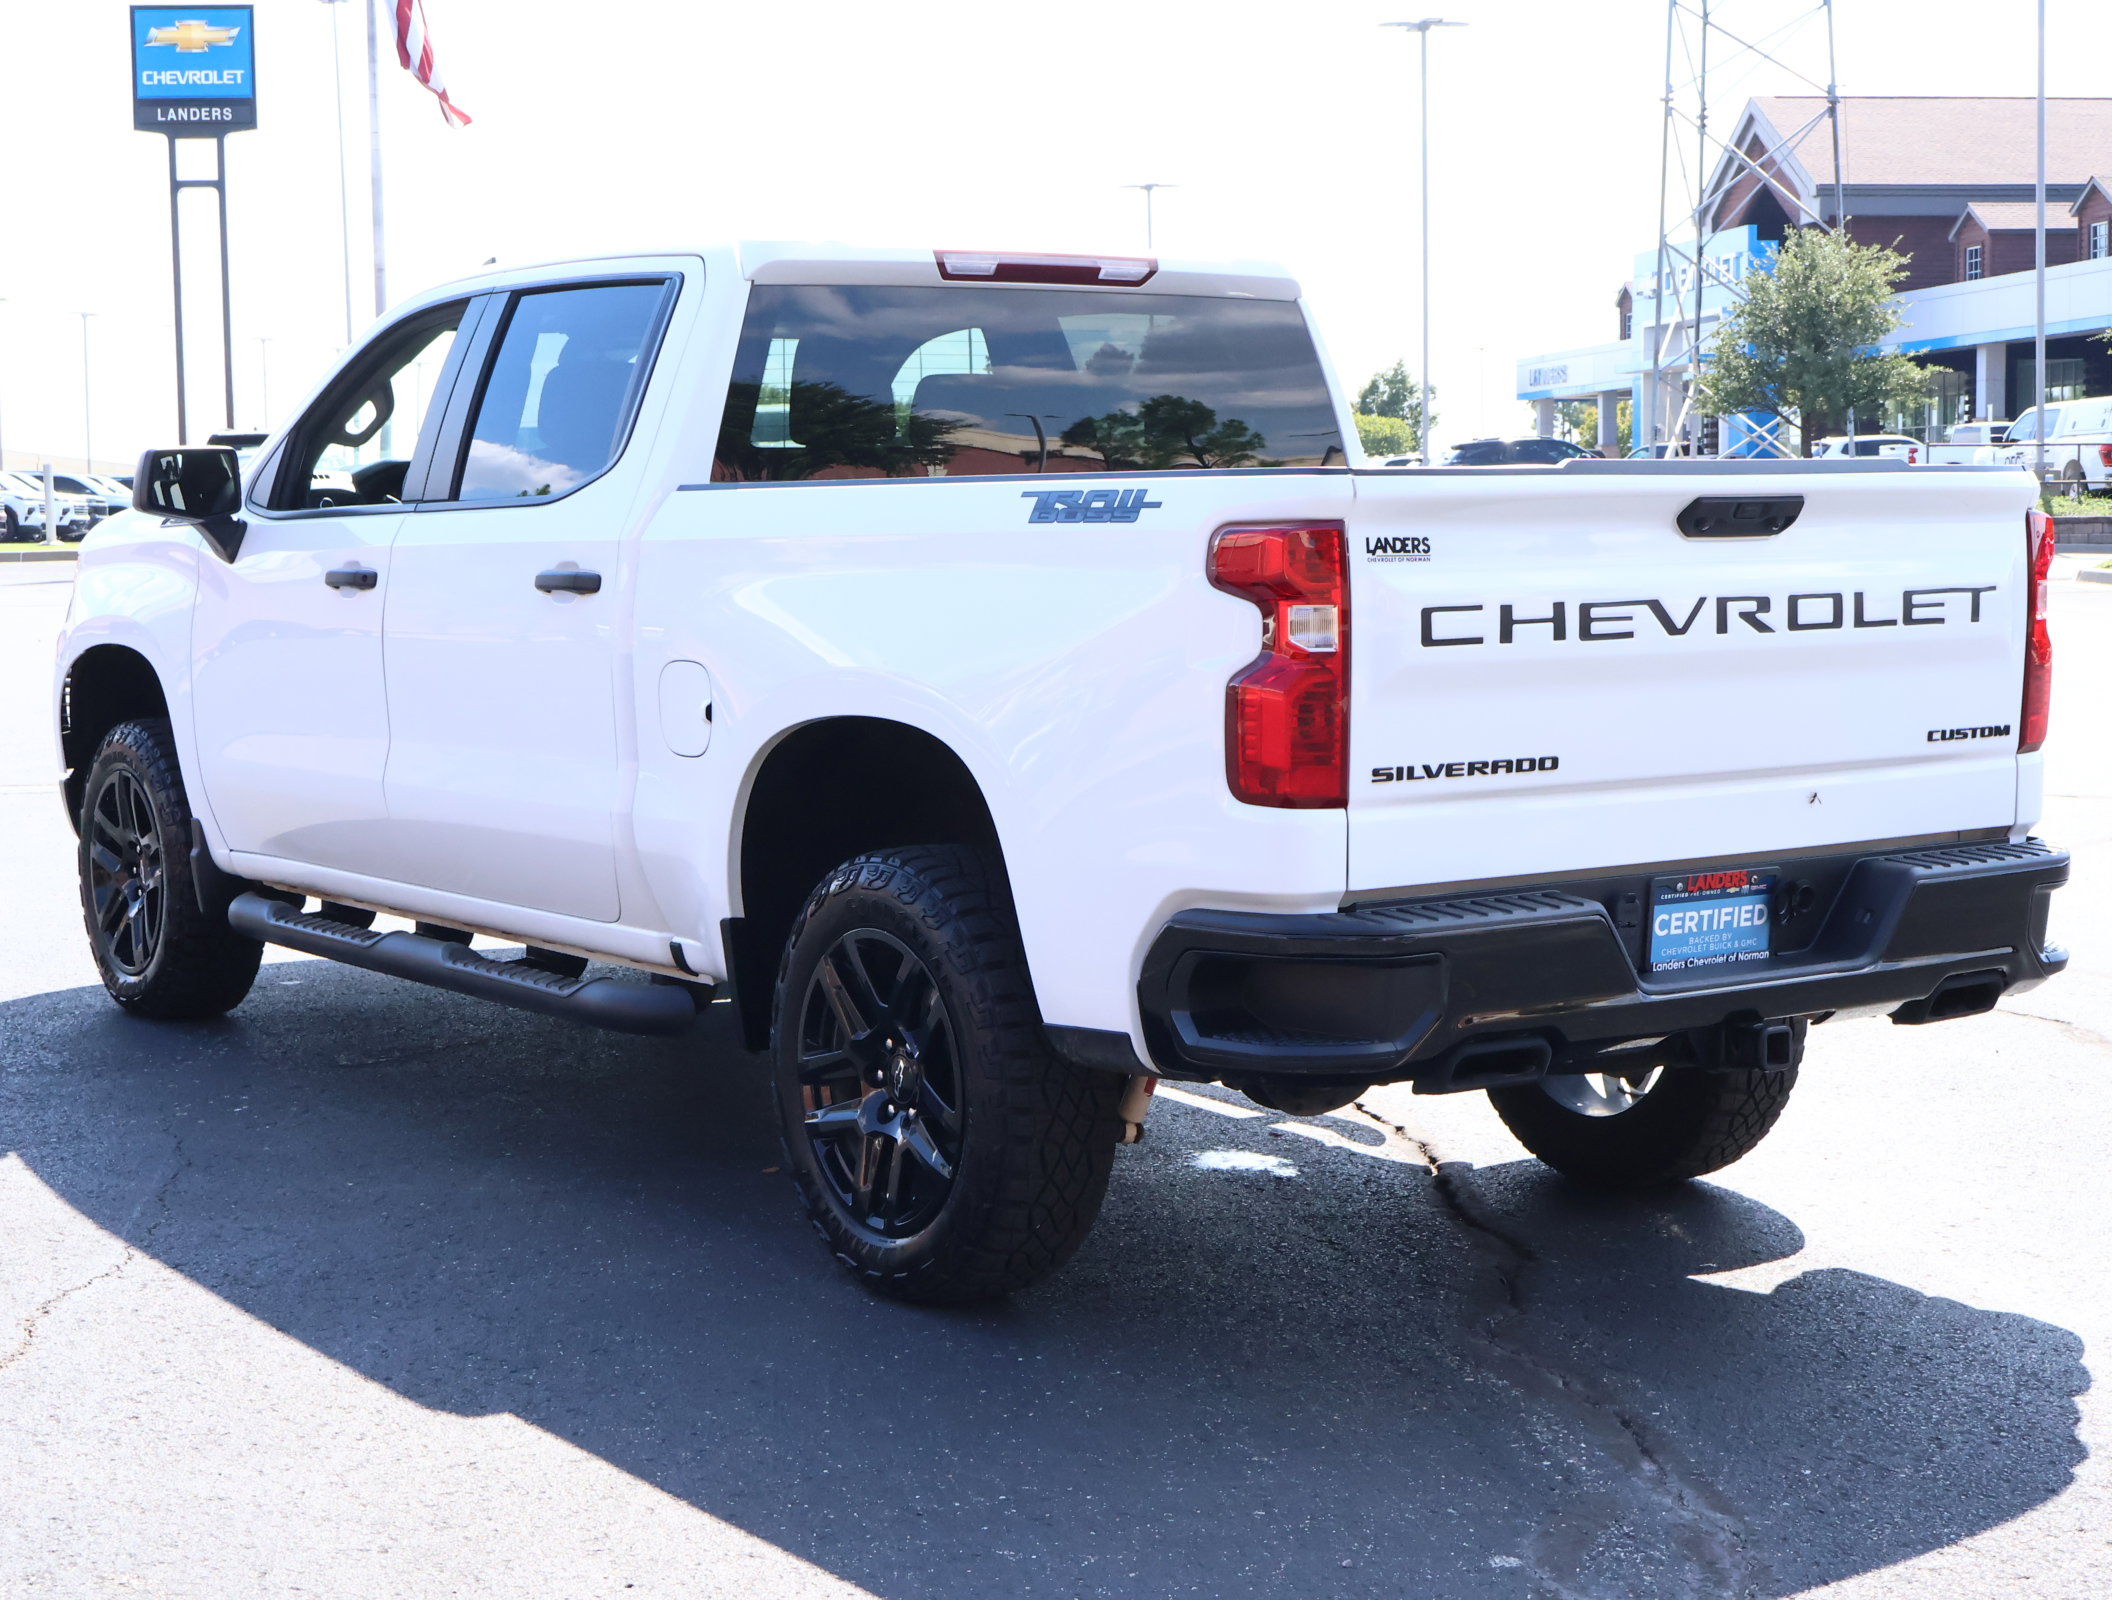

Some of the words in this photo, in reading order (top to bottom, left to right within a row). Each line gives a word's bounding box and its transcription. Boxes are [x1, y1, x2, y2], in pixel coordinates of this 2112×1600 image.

[142, 69, 245, 85] CHEVROLET
[157, 107, 233, 122] LANDERS
[1021, 489, 1163, 509] TRAIL
[1028, 507, 1142, 524] BOSS
[1365, 537, 1431, 556] LANDERS
[1420, 585, 1997, 648] CHEVROLET
[1927, 724, 2010, 742] CUSTOM
[1371, 755, 1559, 783] SILVERADO
[1687, 870, 1749, 893] LANDERS
[1660, 891, 1689, 900] CERTIFIED
[1654, 903, 1769, 937] CERTIFIED
[1661, 943, 1707, 957] CHEVROLET
[1709, 941, 1732, 951] BUICK
[1741, 937, 1758, 947] GMC
[1689, 934, 1720, 945] BACKED
[1722, 932, 1733, 942] BY
[1652, 957, 1686, 972] Landers
[1687, 953, 1728, 968] Chevrolet
[1728, 953, 1738, 962] of
[1738, 950, 1770, 961] Norman
